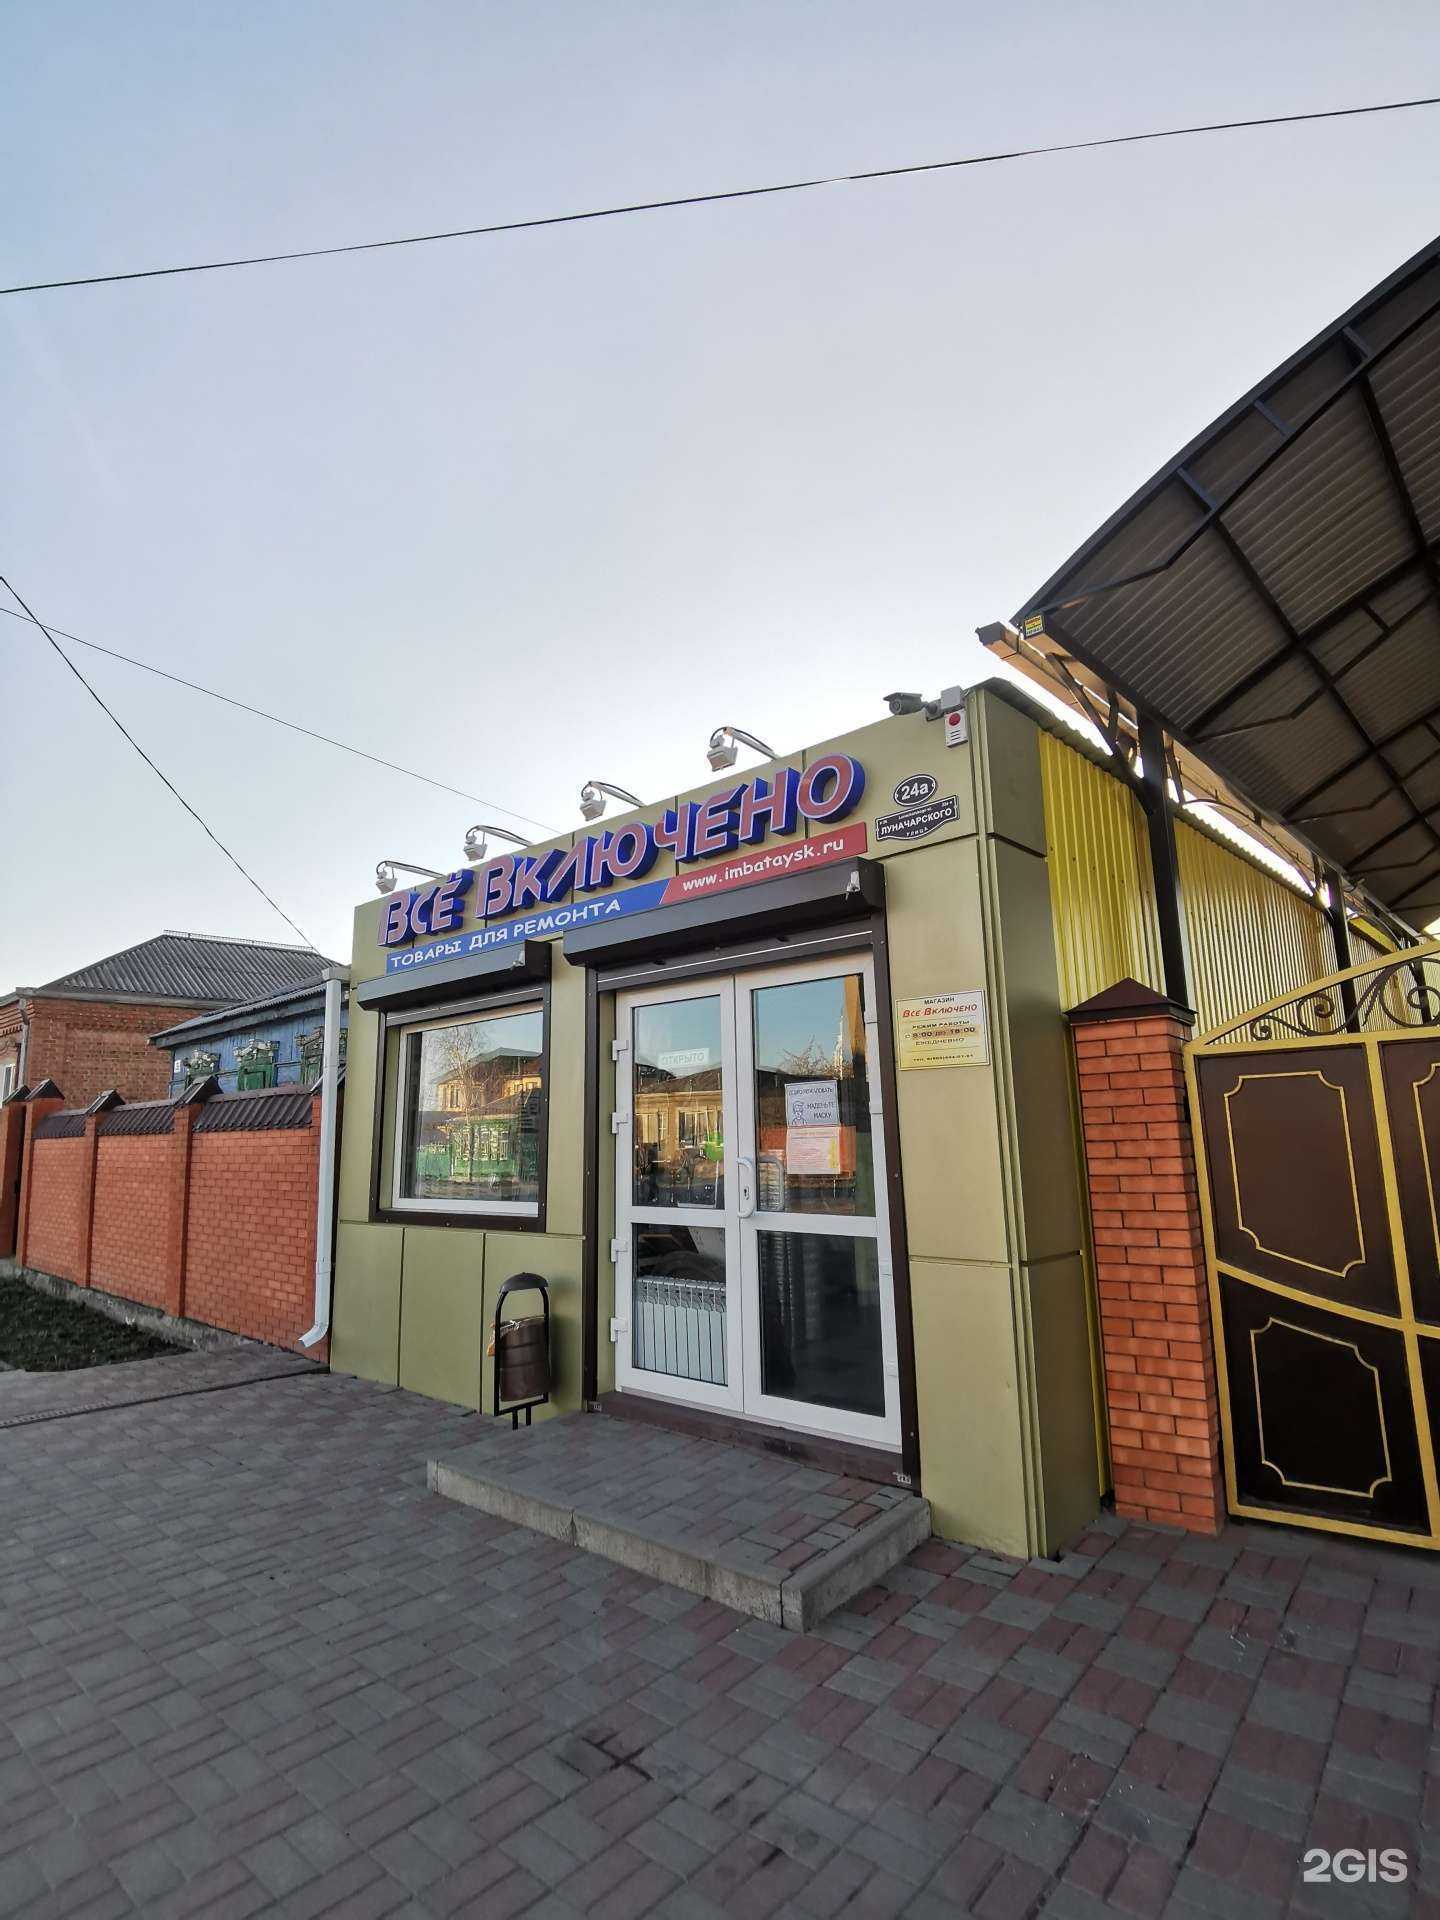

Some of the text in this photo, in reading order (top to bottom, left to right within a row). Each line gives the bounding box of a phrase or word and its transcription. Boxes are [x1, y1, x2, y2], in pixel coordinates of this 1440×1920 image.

[881, 808, 952, 835] ЛУНАЧАРСКОГО
[907, 827, 928, 836] УЛИЦА
[682, 836, 846, 892] www.imbataysk.ru
[391, 898, 622, 969] ТОВАРЫ ДЛЯ РЕМОНТА
[924, 997, 954, 1005] МАГАЗИН
[661, 1052, 705, 1065] ОТКРЫТО
